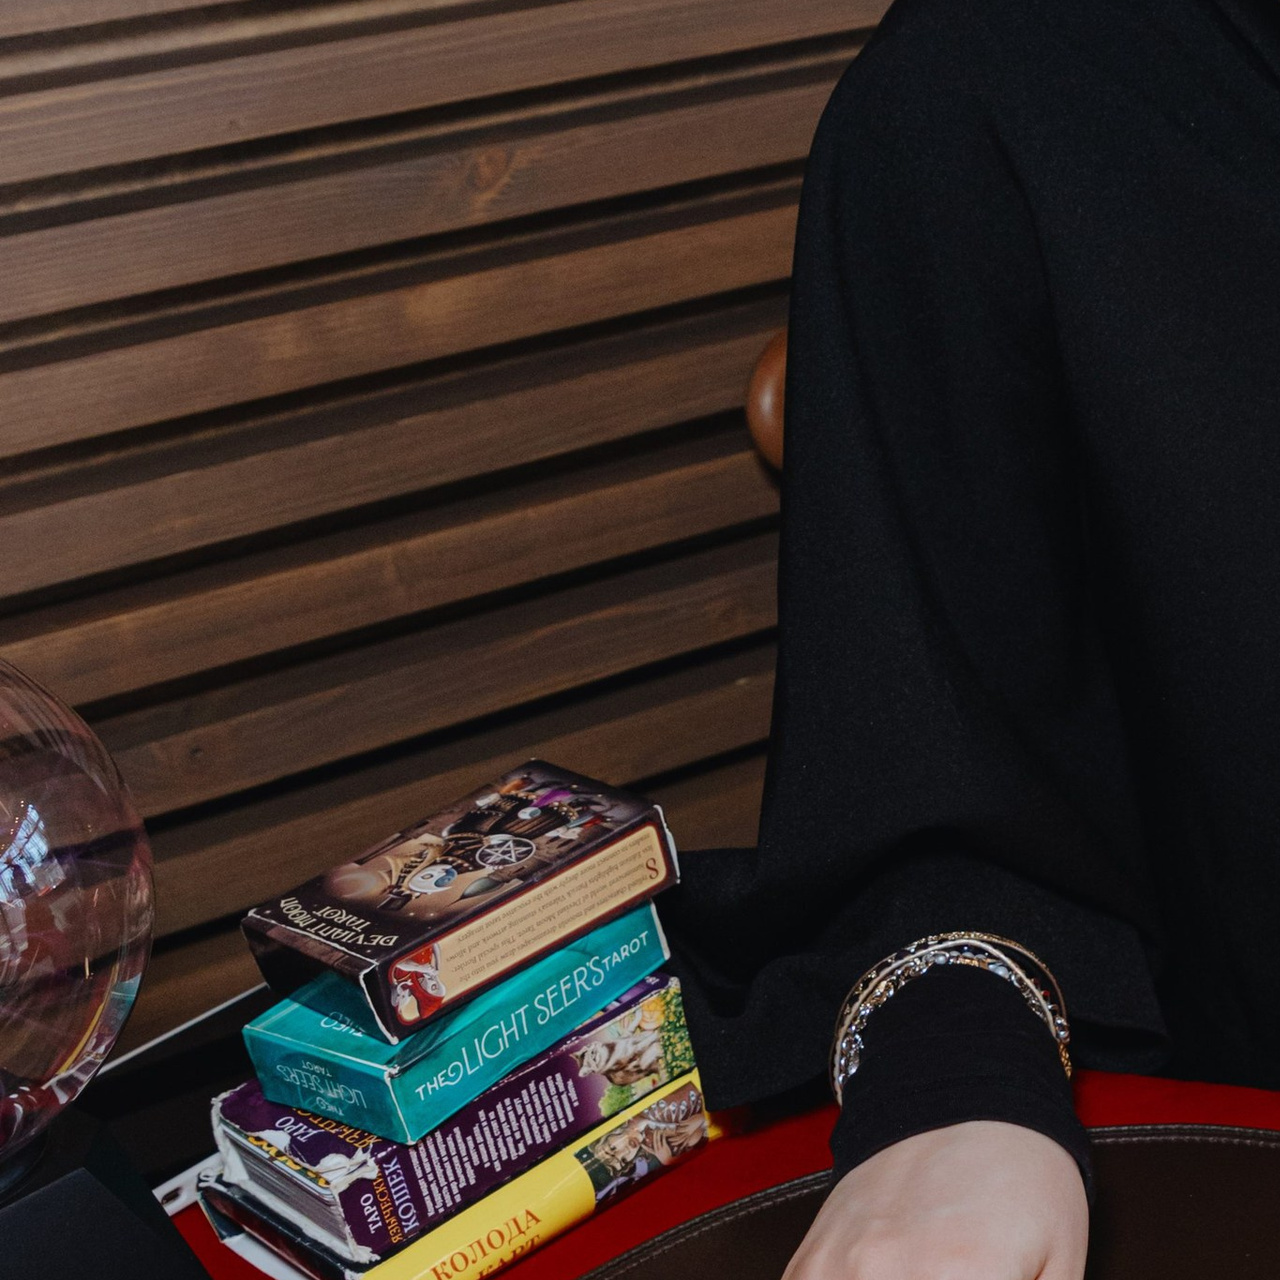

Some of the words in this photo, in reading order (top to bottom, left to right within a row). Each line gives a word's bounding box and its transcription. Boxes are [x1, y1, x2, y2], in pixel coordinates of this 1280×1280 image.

[279, 897, 317, 927] MOON
[312, 906, 371, 932] TAROT
[306, 922, 399, 946] DEVIANT
[461, 1004, 529, 1075] LIGHT
[601, 930, 650, 972] TAROT
[360, 1193, 383, 1234] ТАРО
[373, 1170, 404, 1243] ЯЗЫЧЕСКИ
[383, 1156, 419, 1234] КОШЕК
